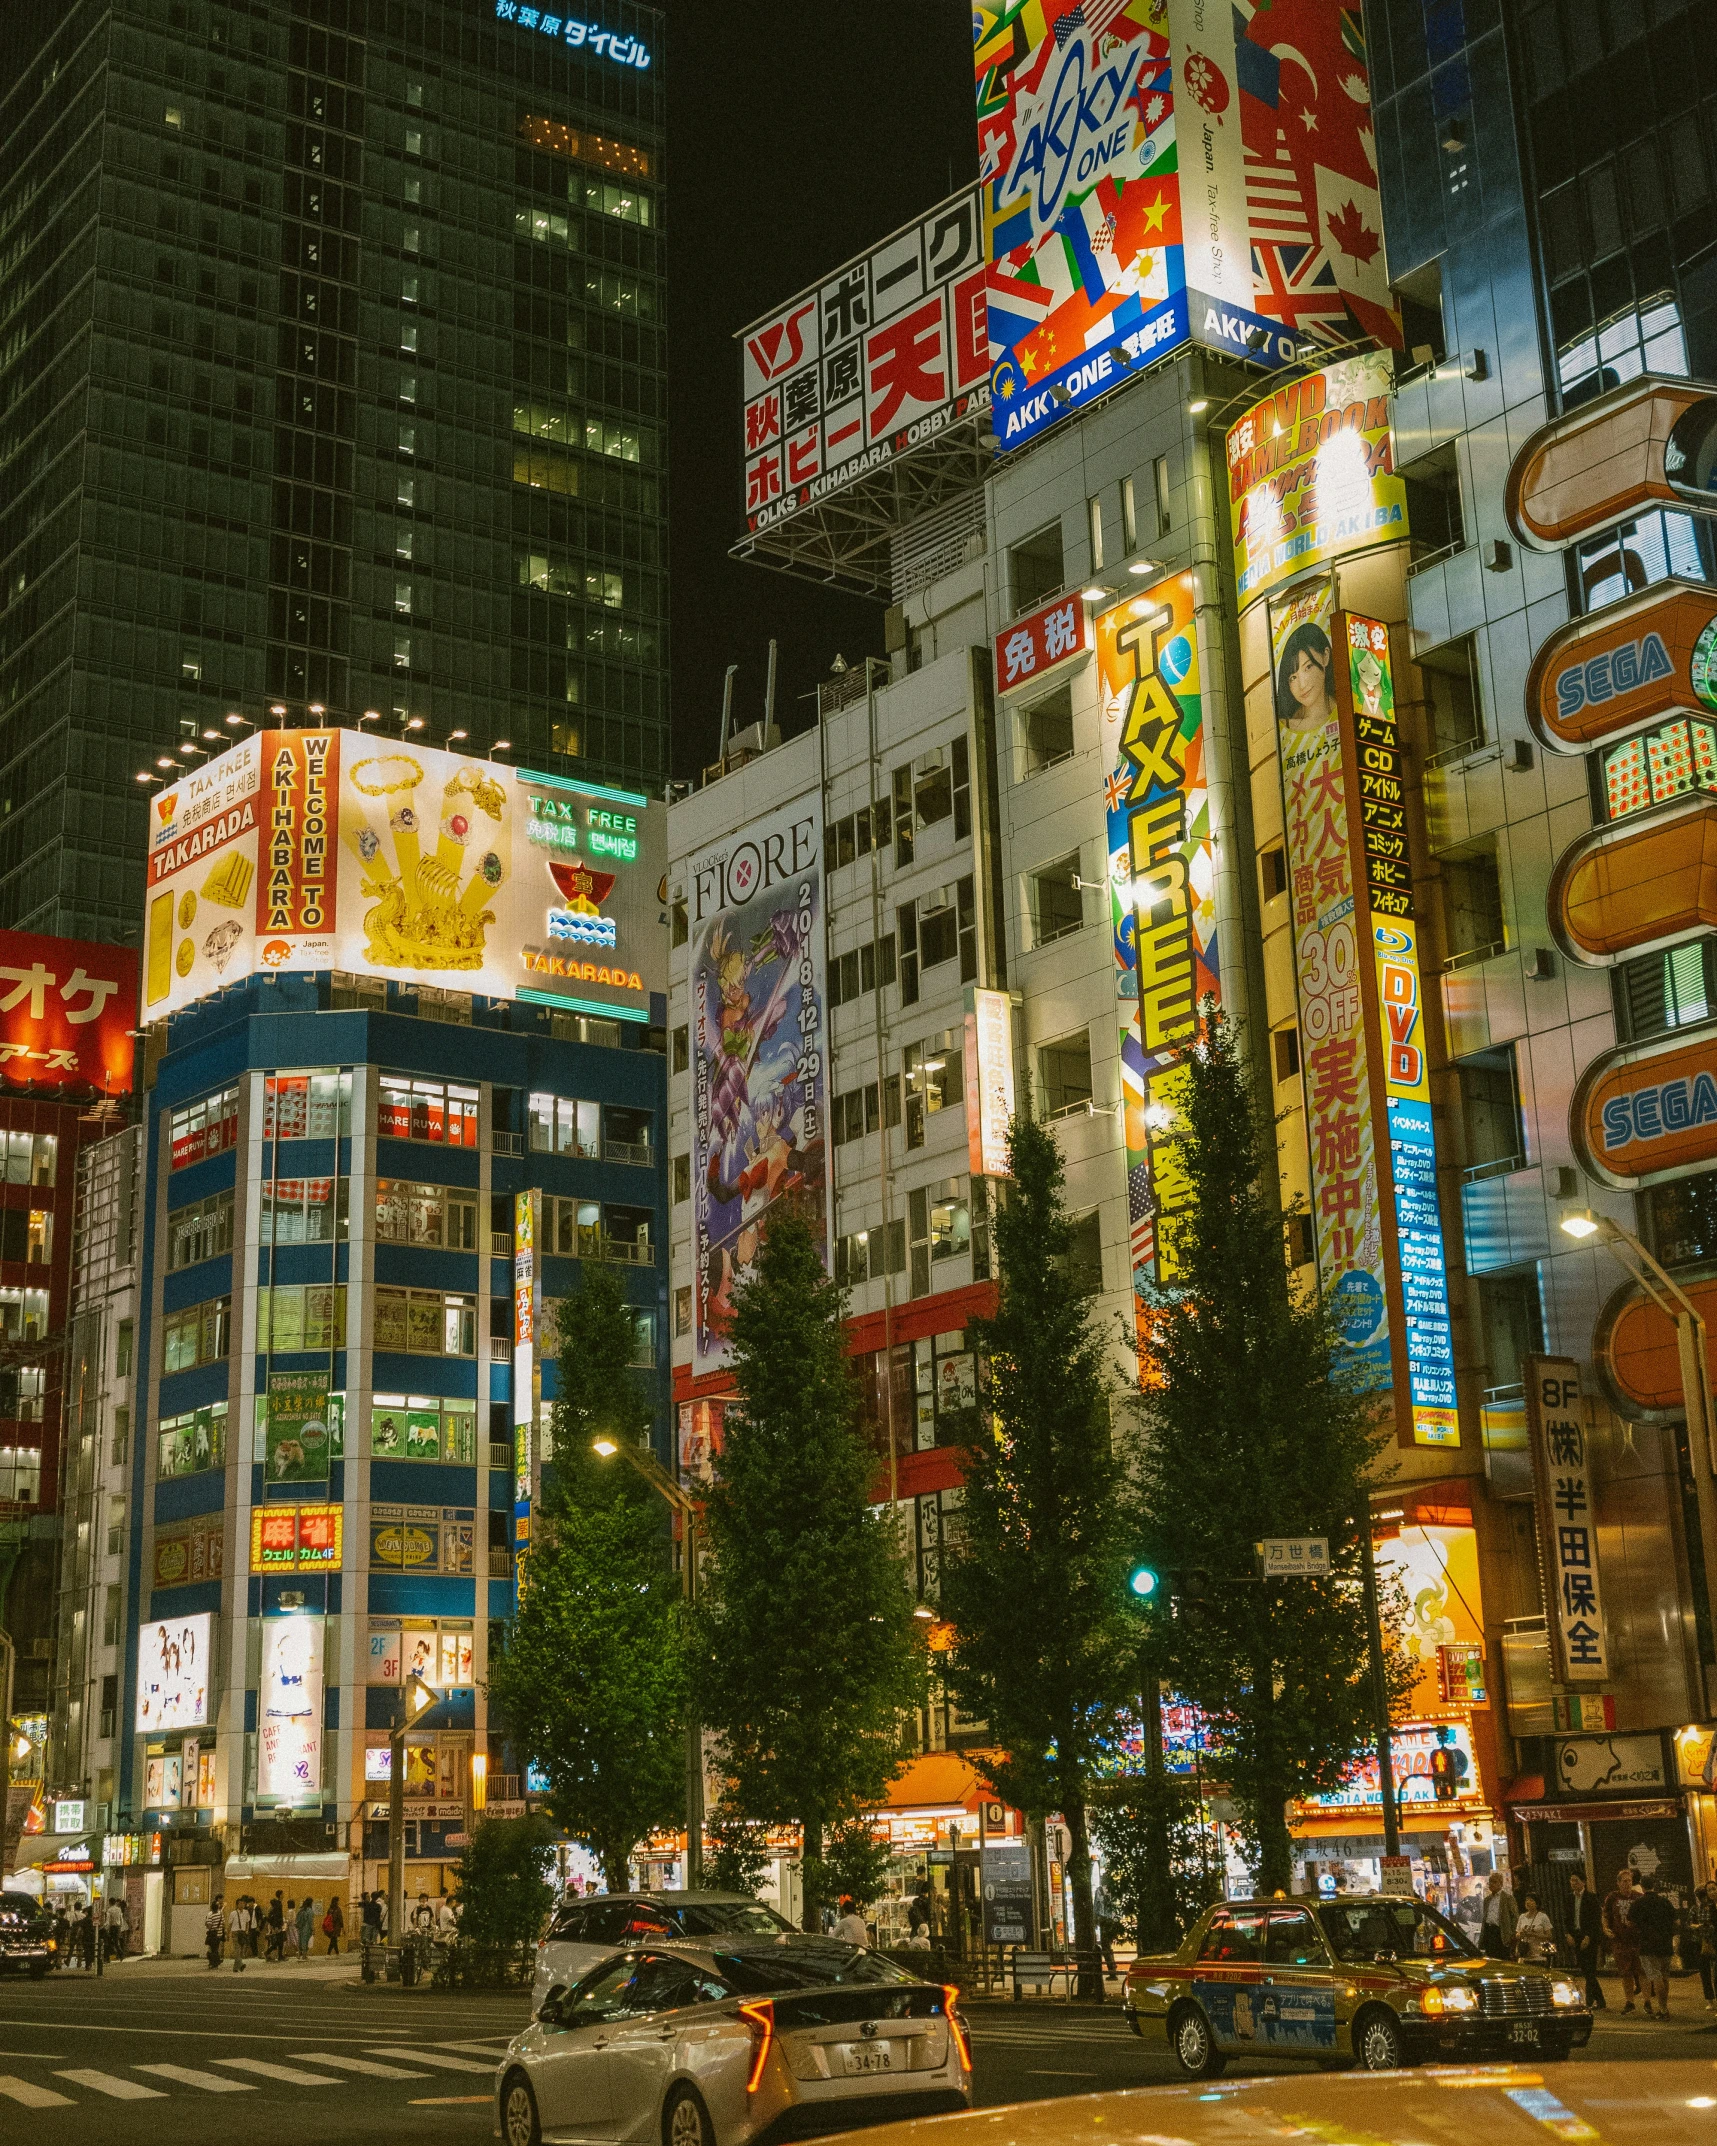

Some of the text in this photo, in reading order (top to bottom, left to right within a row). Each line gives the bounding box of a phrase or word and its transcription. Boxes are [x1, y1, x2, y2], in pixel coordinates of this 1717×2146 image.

[1078, 120, 1130, 182] ONE
[1203, 122, 1223, 285] Japan. Tax-free Shop
[1064, 351, 1114, 405] ONE
[746, 351, 859, 450] 秋葉原
[1254, 373, 1327, 447] DVD
[747, 418, 861, 510] ホビー
[748, 493, 797, 532] VOLKS
[799, 441, 893, 506] AKIHABARA
[896, 404, 954, 451] HOBBY
[1275, 524, 1328, 567] WORLD
[1335, 503, 1403, 538] AKIBA
[1004, 602, 1077, 682] 免税
[1556, 632, 1675, 721] SEGA
[1119, 609, 1182, 803] TAX
[1358, 718, 1395, 747] ゲーム
[1364, 749, 1393, 772] CD
[1362, 775, 1401, 799] アイドル
[530, 796, 637, 833] TAX FREE
[1364, 802, 1403, 829] アニメ
[153, 802, 255, 879] TAKARADA
[270, 749, 296, 928] AKIHABARA
[303, 737, 331, 927] WELCOME TO
[1310, 760, 1349, 904] 大人気
[1367, 832, 1404, 858] コミック
[693, 816, 818, 924] FIORE
[1371, 860, 1406, 884] ホビー
[1372, 888, 1409, 915] フィギュア
[1130, 797, 1197, 1052] FREE
[302, 939, 329, 949] Japan.
[521, 952, 643, 991] TAKARADA
[1304, 984, 1359, 1041] OFF
[1382, 963, 1423, 1088] DVD
[379, 1114, 442, 1132] HARERUYA
[516, 1266, 532, 1280] 麻雀
[1401, 1272, 1412, 1283] 2F
[1406, 1316, 1417, 1327] 1F
[1409, 1361, 1421, 1373] B1
[263, 1517, 332, 1546] 麻雀
[517, 1519, 529, 1539] 薬
[1542, 1378, 1603, 1665] 8F (株)半田保全
[322, 1548, 334, 1559] 4F
[1268, 1543, 1323, 1560] 万世橋
[1268, 1562, 1327, 1571] Manseibashi Bridge
[371, 1637, 385, 1655] 2F
[383, 1659, 399, 1677] 3F
[59, 1817, 81, 1830] 買取
[1519, 1808, 1563, 1821] TAIYAKI
[1513, 2029, 1539, 2042] 32-02
[855, 2053, 890, 2070] 34-78
